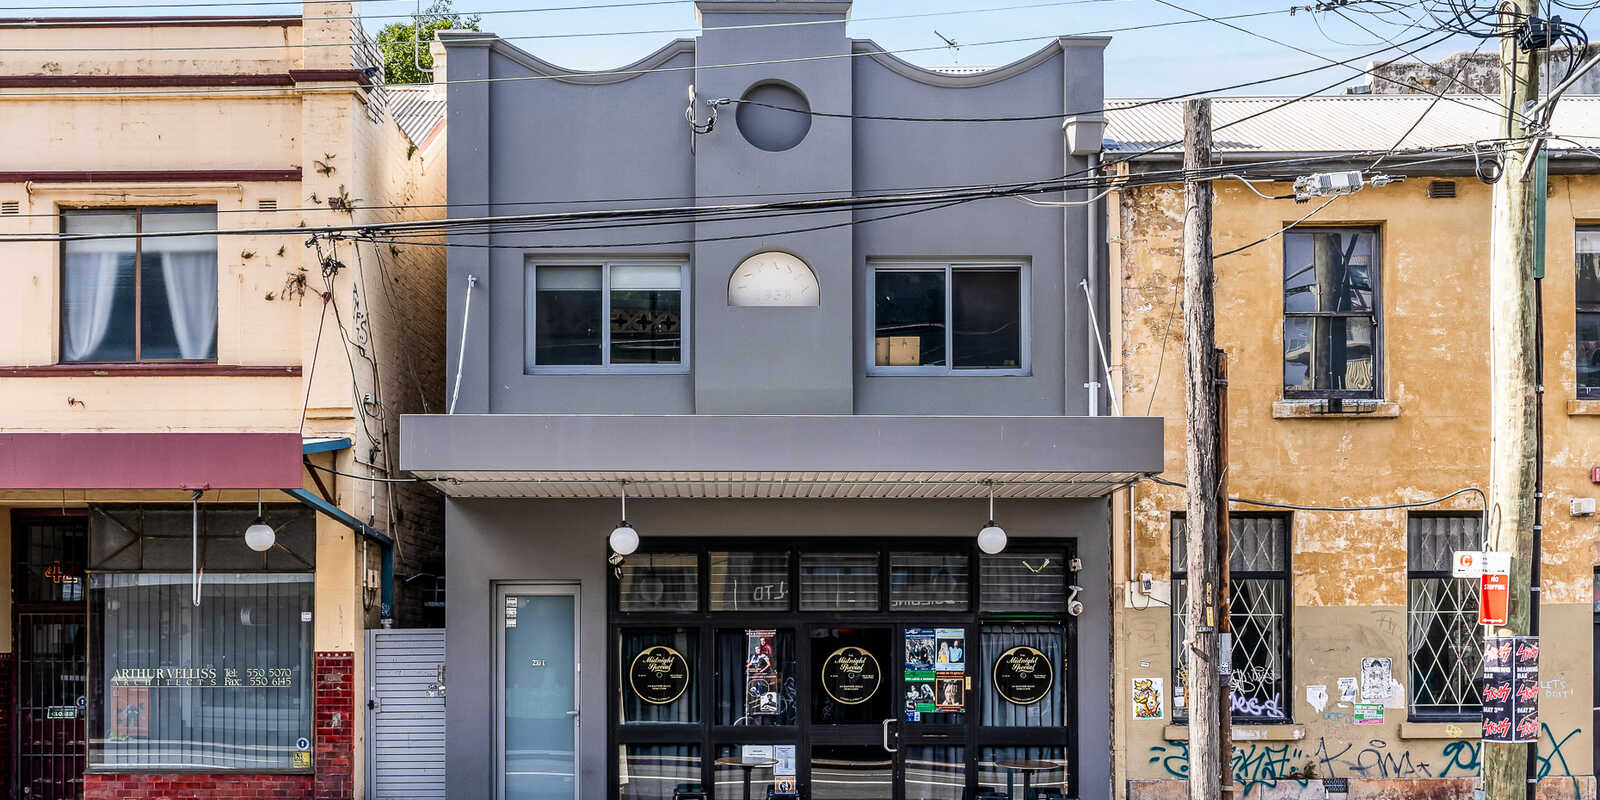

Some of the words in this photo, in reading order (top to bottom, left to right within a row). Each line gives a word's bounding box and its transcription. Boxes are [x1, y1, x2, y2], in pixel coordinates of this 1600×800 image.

[113, 668, 164, 679] ARTHUR
[246, 668, 265, 678] 550
[268, 668, 292, 678] 5070
[113, 678, 217, 686] ARCHITECTS
[249, 677, 268, 686] 550
[271, 677, 292, 686] 6145
